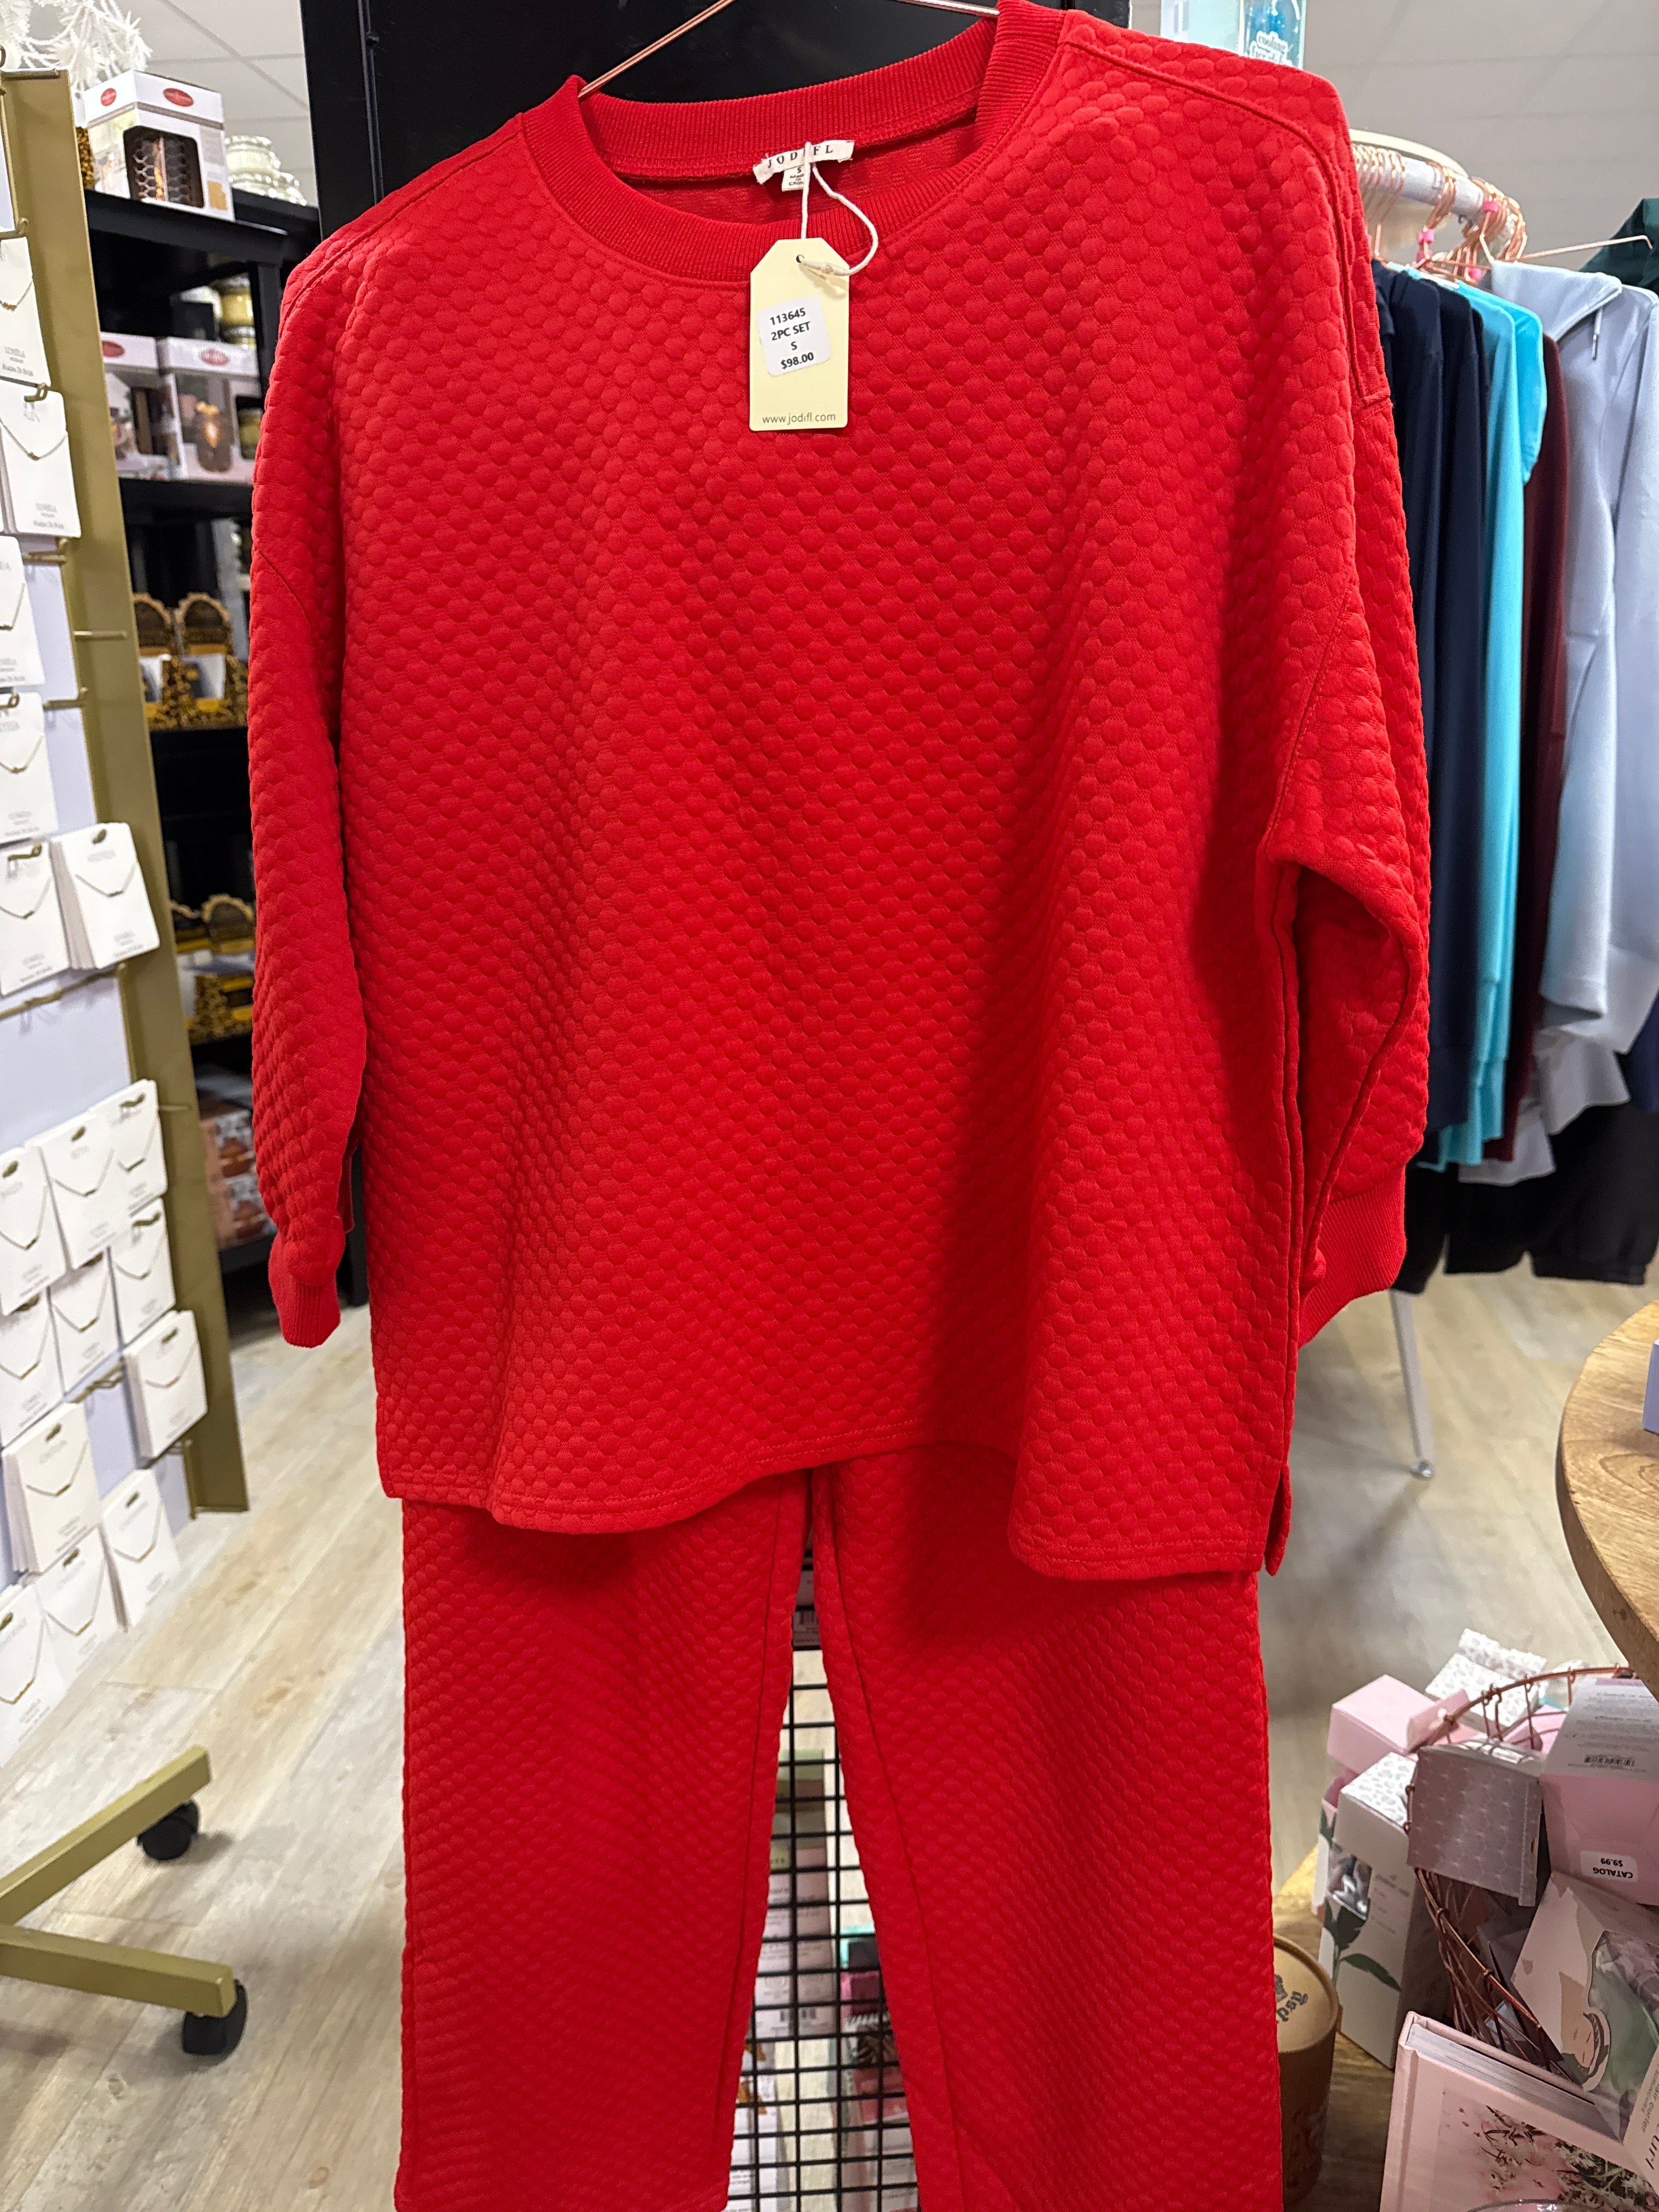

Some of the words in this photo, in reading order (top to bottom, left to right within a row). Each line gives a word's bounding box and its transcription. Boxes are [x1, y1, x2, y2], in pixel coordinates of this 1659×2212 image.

[770, 307, 806, 325] 113645
[771, 328, 791, 341] 2PC
[793, 321, 810, 334] SET
[791, 341, 797, 350] S
[781, 352, 814, 369] $98.00
[763, 412, 836, 425] www.jodifl.com
[1600, 1858, 1623, 1867] $9.99
[1593, 1867, 1633, 1878] CATALOG
